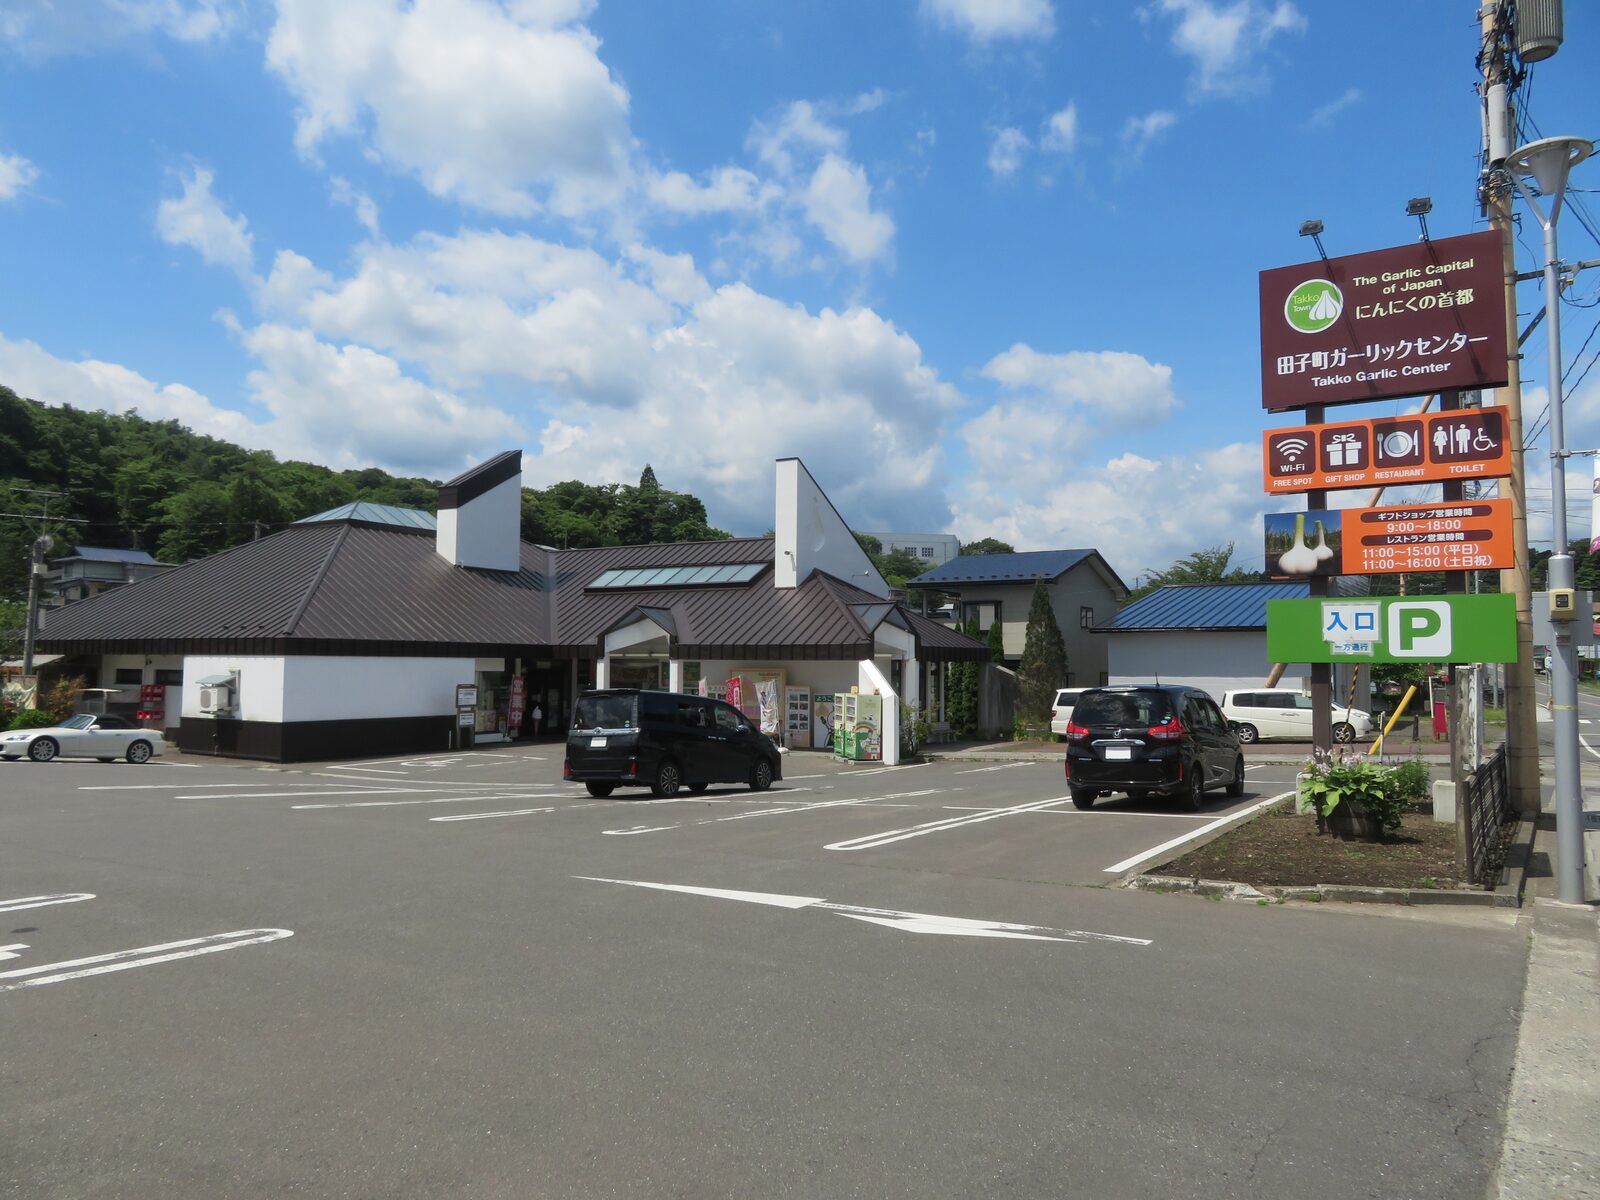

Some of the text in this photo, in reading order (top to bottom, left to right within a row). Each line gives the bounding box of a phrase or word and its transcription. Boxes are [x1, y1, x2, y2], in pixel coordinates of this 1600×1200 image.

[1353, 259, 1474, 287] The Garlic Capital
[1383, 277, 1442, 294] of Japan
[1292, 293, 1320, 304] Takko
[1356, 288, 1474, 319] にんにくの首都
[1277, 332, 1488, 375] 田子町ガーリックセンター
[1312, 362, 1450, 387] Takko Garlic Center
[1280, 464, 1305, 472] Wi-Fi
[1449, 464, 1485, 473] TOILET
[1325, 473, 1365, 483] GIFT SHOP
[1375, 469, 1424, 479] RESTAURANT
[1273, 479, 1292, 487] FREE
[1378, 508, 1473, 520] ギフトショップ営業時間
[1387, 533, 1464, 544] レストラン営業時間
[1327, 612, 1374, 631] 入口
[1400, 608, 1441, 650] P
[1334, 643, 1368, 651] 一方通行
